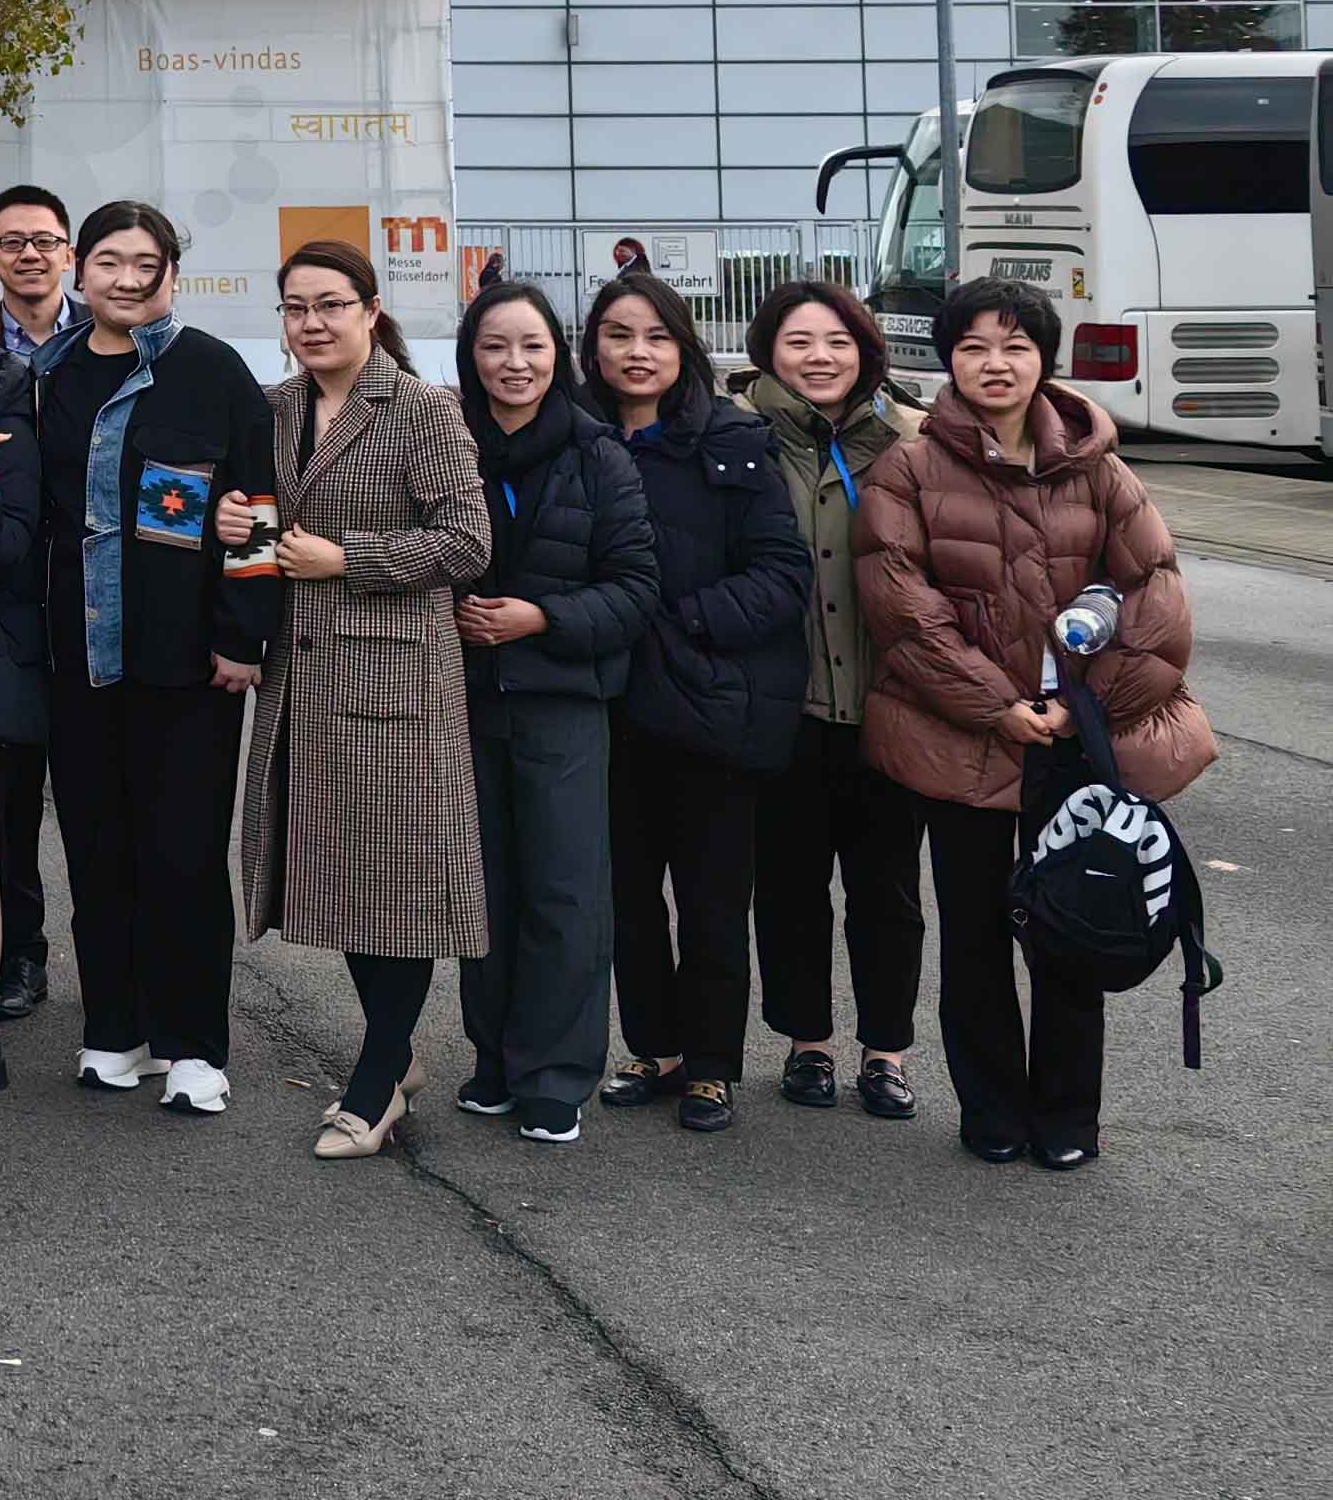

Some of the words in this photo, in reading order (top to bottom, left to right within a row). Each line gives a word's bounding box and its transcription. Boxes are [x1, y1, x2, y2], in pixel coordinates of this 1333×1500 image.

[138, 47, 302, 72] Boas-vindas
[388, 257, 422, 268] Messe
[388, 269, 449, 283] Düsseldorf
